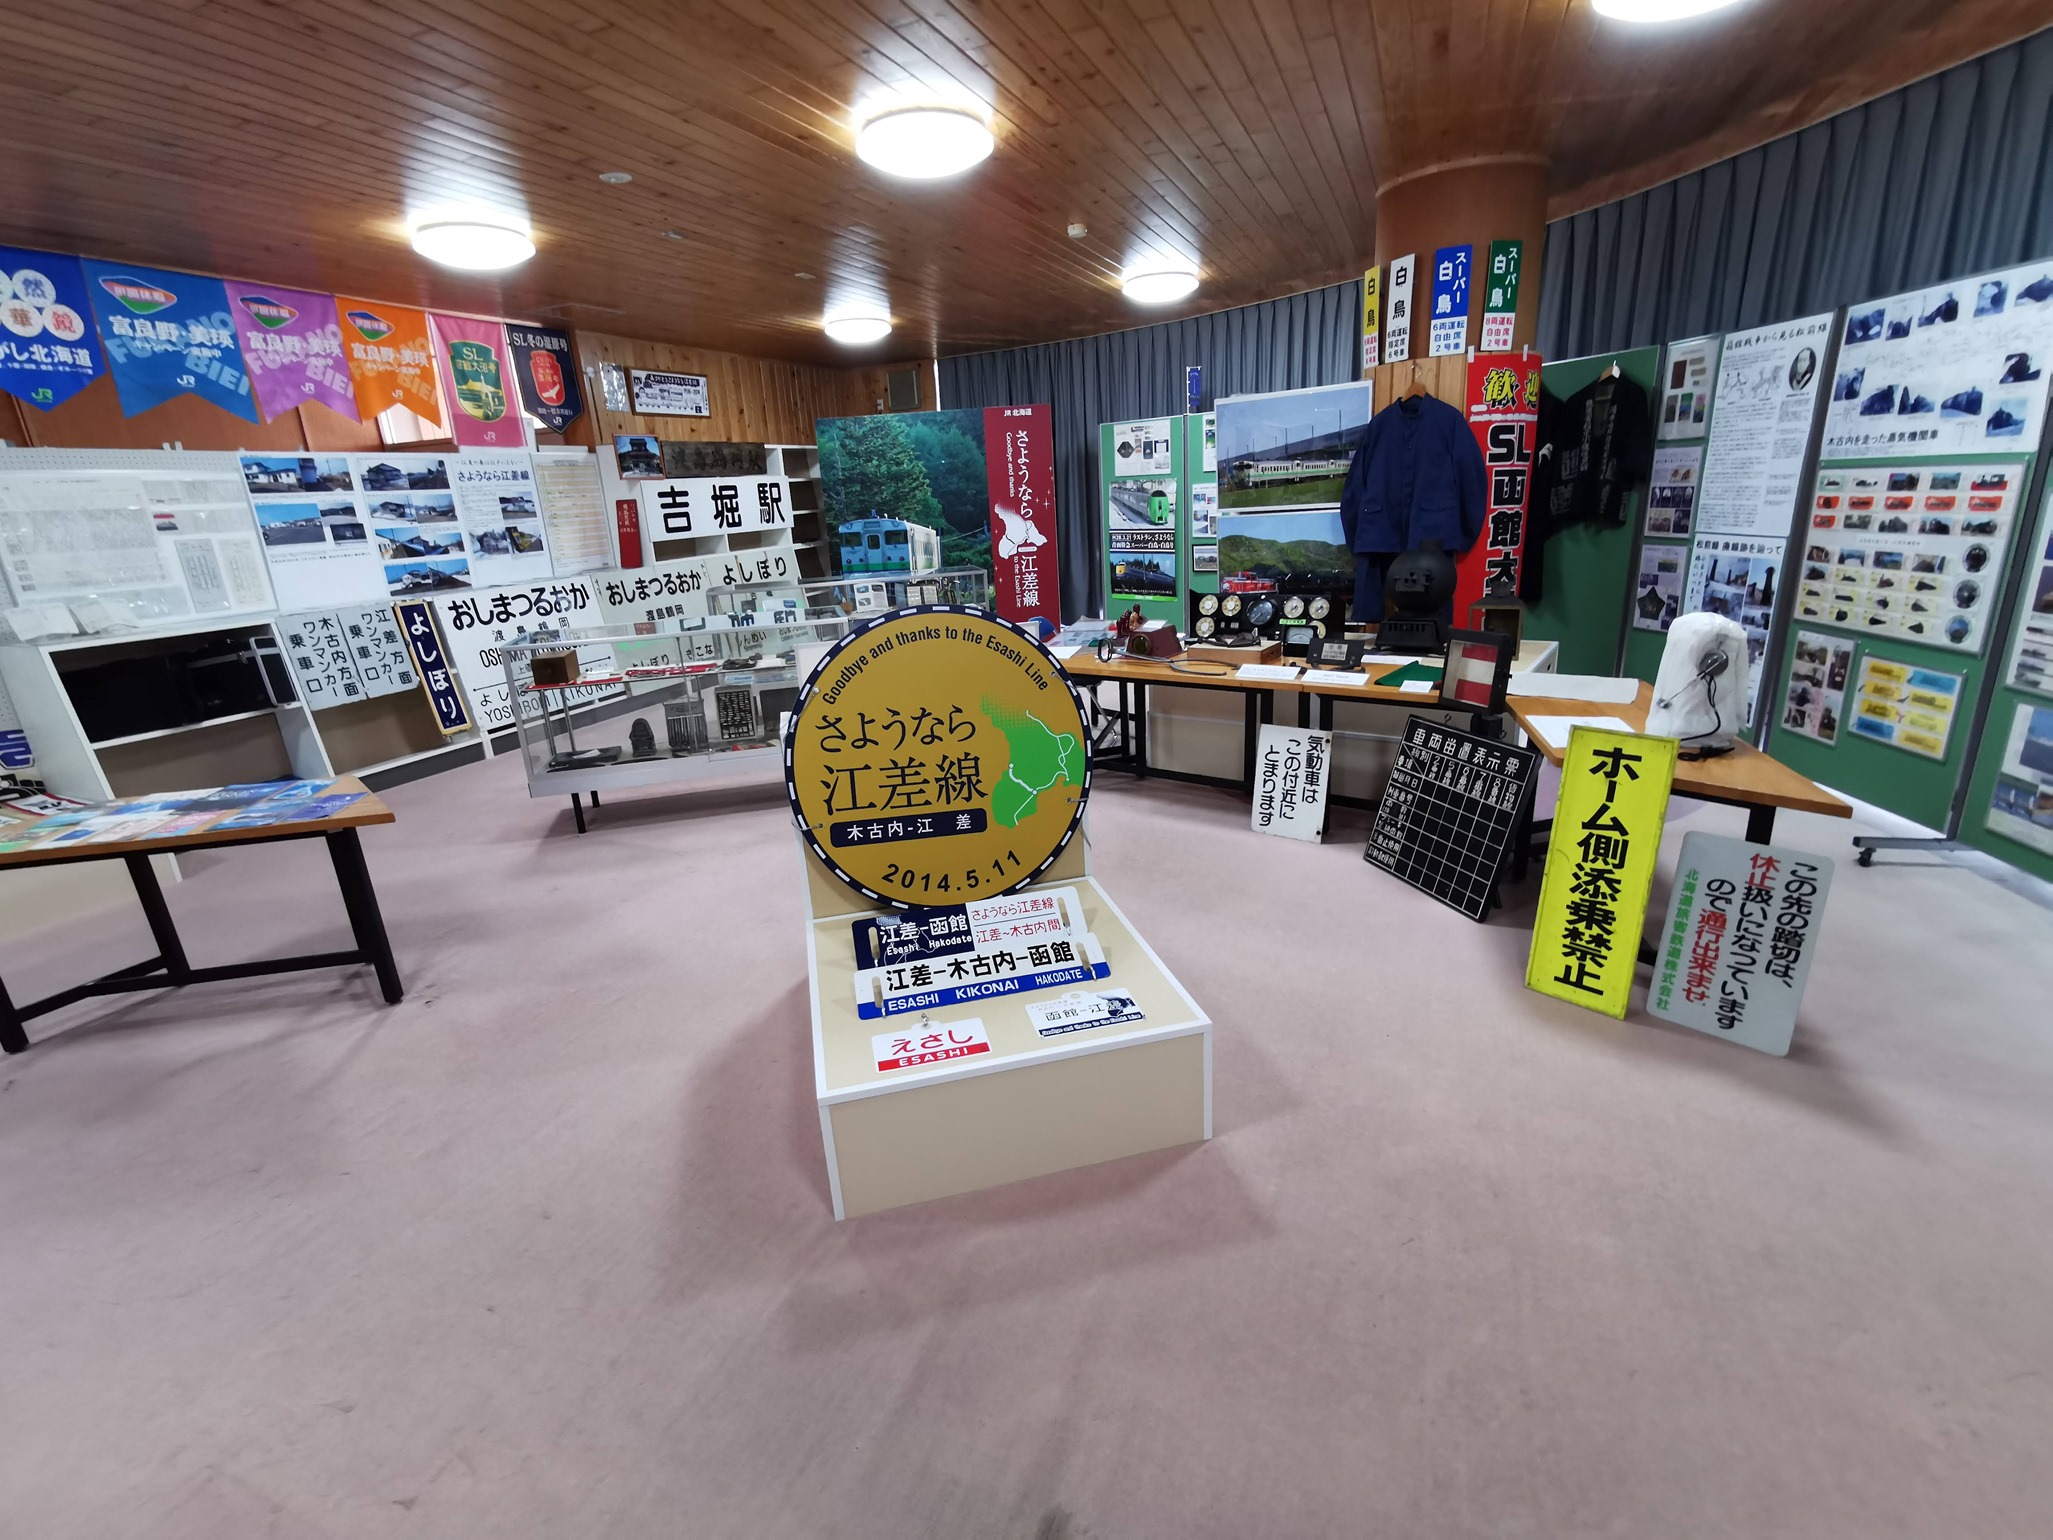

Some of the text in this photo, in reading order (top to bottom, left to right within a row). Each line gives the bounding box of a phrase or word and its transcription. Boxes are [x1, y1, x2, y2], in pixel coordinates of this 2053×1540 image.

[1392, 265, 1408, 320] 白鳥
[1436, 260, 1453, 315] 白鳥
[1453, 252, 1467, 304] スーパー
[1489, 254, 1506, 308] 白鳥
[1505, 247, 1519, 299] スーパー
[1366, 277, 1376, 328] 白鳥
[1433, 319, 1465, 332] 6両運転
[463, 347, 483, 361] SL
[1387, 326, 1408, 340] 6両運転
[1388, 348, 1405, 359] 6号車
[1435, 331, 1462, 342] 自由席
[1436, 342, 1461, 353] 2号車
[1487, 327, 1511, 337] 自由席
[1487, 338, 1509, 348] 2号車
[1484, 368, 1540, 410] 歓迎
[1826, 429, 1939, 447] 木古内を走った蒸気機関車
[458, 469, 531, 482] さようなら江差線
[1016, 430, 1033, 519] さようなら
[657, 483, 786, 534] 吉堀駅
[606, 570, 702, 606] おしまつるおか
[723, 557, 788, 586] よしぼり
[1021, 555, 1040, 607] 江差線
[448, 582, 591, 632] おしまつるおか
[289, 633, 324, 694] 乗車口
[303, 621, 338, 698] ワンマンカー
[319, 617, 360, 698] 木古内方面
[348, 624, 379, 682] 乗車口
[361, 612, 394, 686] ワンマンカー
[375, 608, 413, 686] 江差方面
[410, 612, 458, 720] よしぼり
[822, 625, 1049, 705] Goodbye and thanks to the Esashi Line
[815, 703, 977, 753] さようなら
[819, 751, 989, 817] 江差線
[1258, 745, 1281, 828] とまります
[1279, 738, 1302, 820] この付近に
[1301, 735, 1325, 804] 気動車は
[882, 850, 1022, 893] 2014.5.11
[1553, 747, 1643, 996] ホーム側添乗禁止
[971, 896, 1056, 922] さようなら江差線
[1765, 861, 1819, 989] この先の踏切は、
[929, 933, 973, 950] Hakodate
[1656, 867, 1700, 1012] 北海道旅客鉄道株式会社
[1714, 853, 1781, 1031] 休止扱いになっています
[888, 968, 1084, 1012] ESASHI KIKONAI HAKODATE
[891, 1029, 974, 1056] えさし
[899, 1046, 970, 1067] ESASHI
